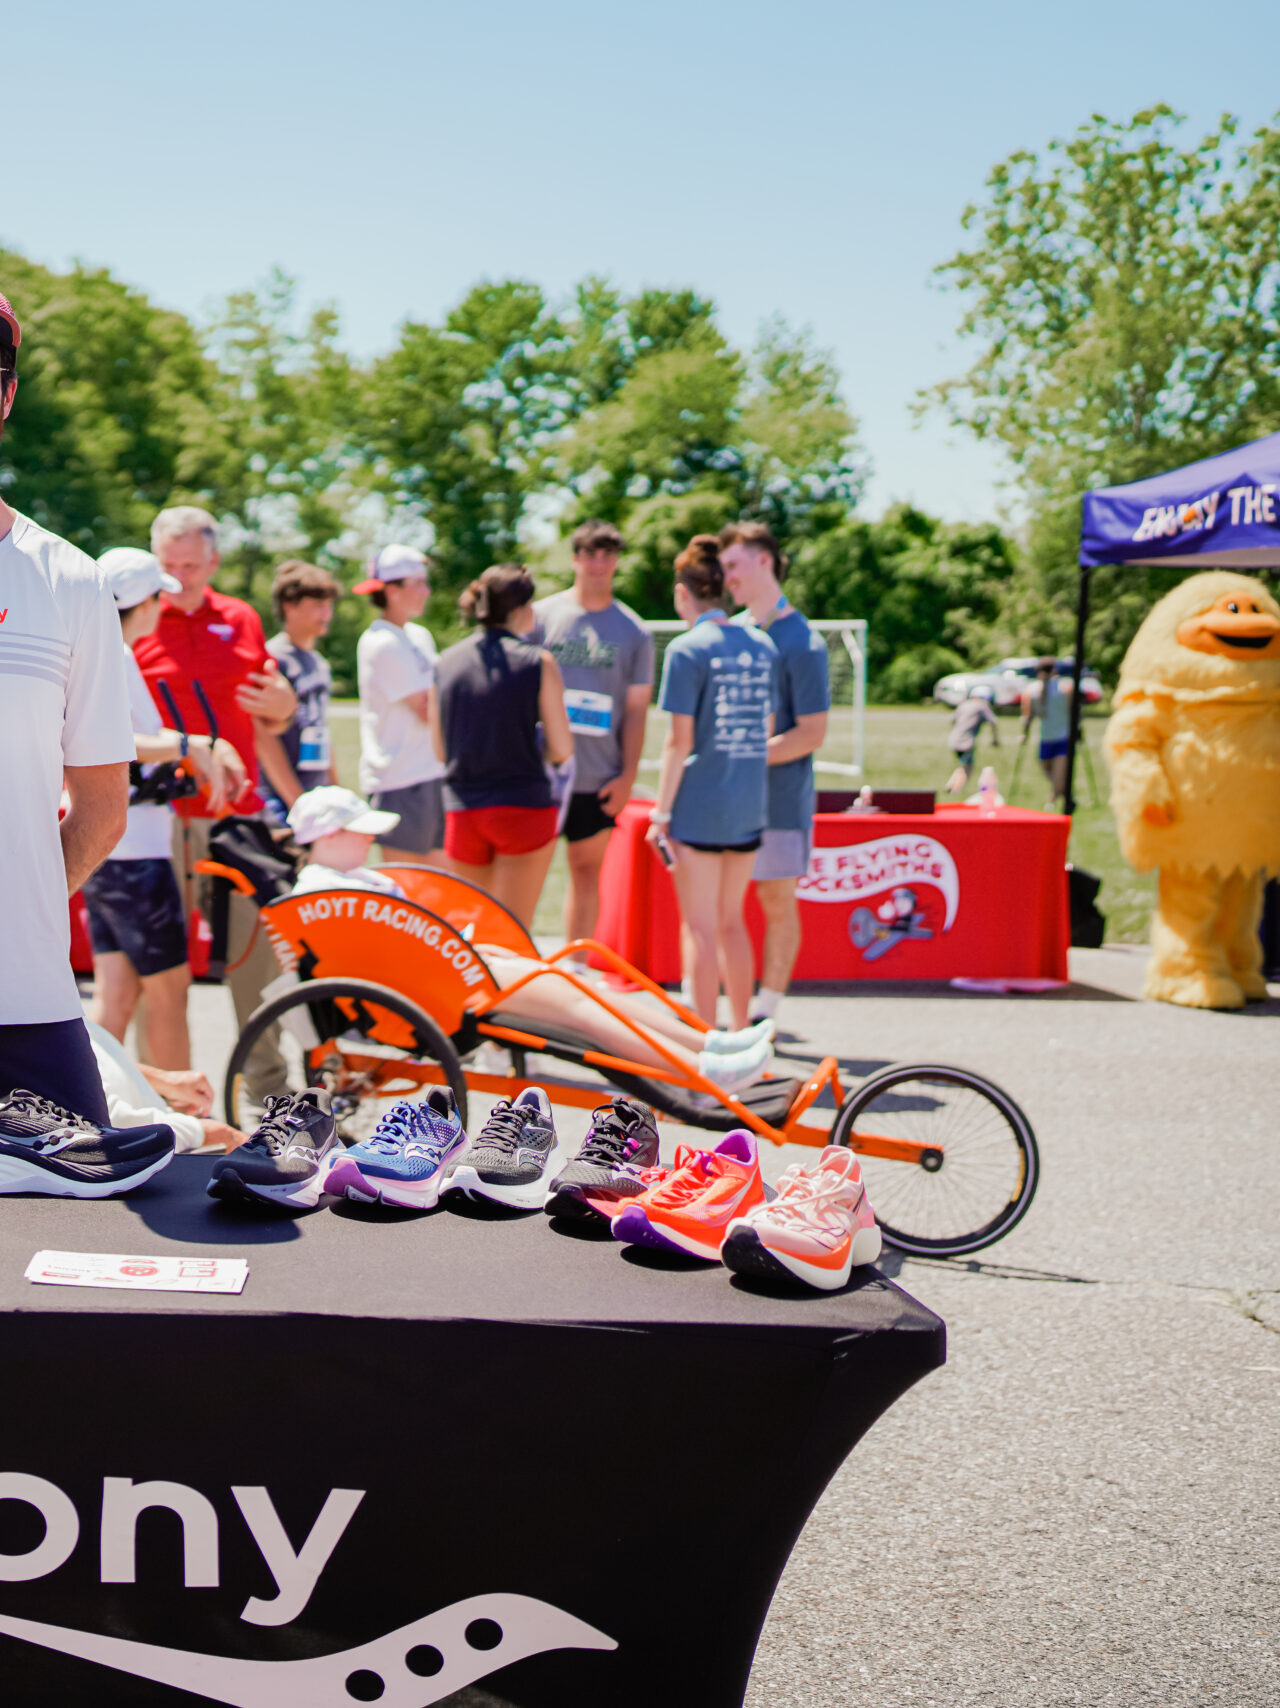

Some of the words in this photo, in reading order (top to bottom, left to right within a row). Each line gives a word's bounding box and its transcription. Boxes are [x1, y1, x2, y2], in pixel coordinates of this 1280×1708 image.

[1227, 484, 1277, 526] THE
[836, 843, 931, 872] FLYING
[297, 897, 359, 925] HOYT
[363, 900, 485, 987] RACING.COM
